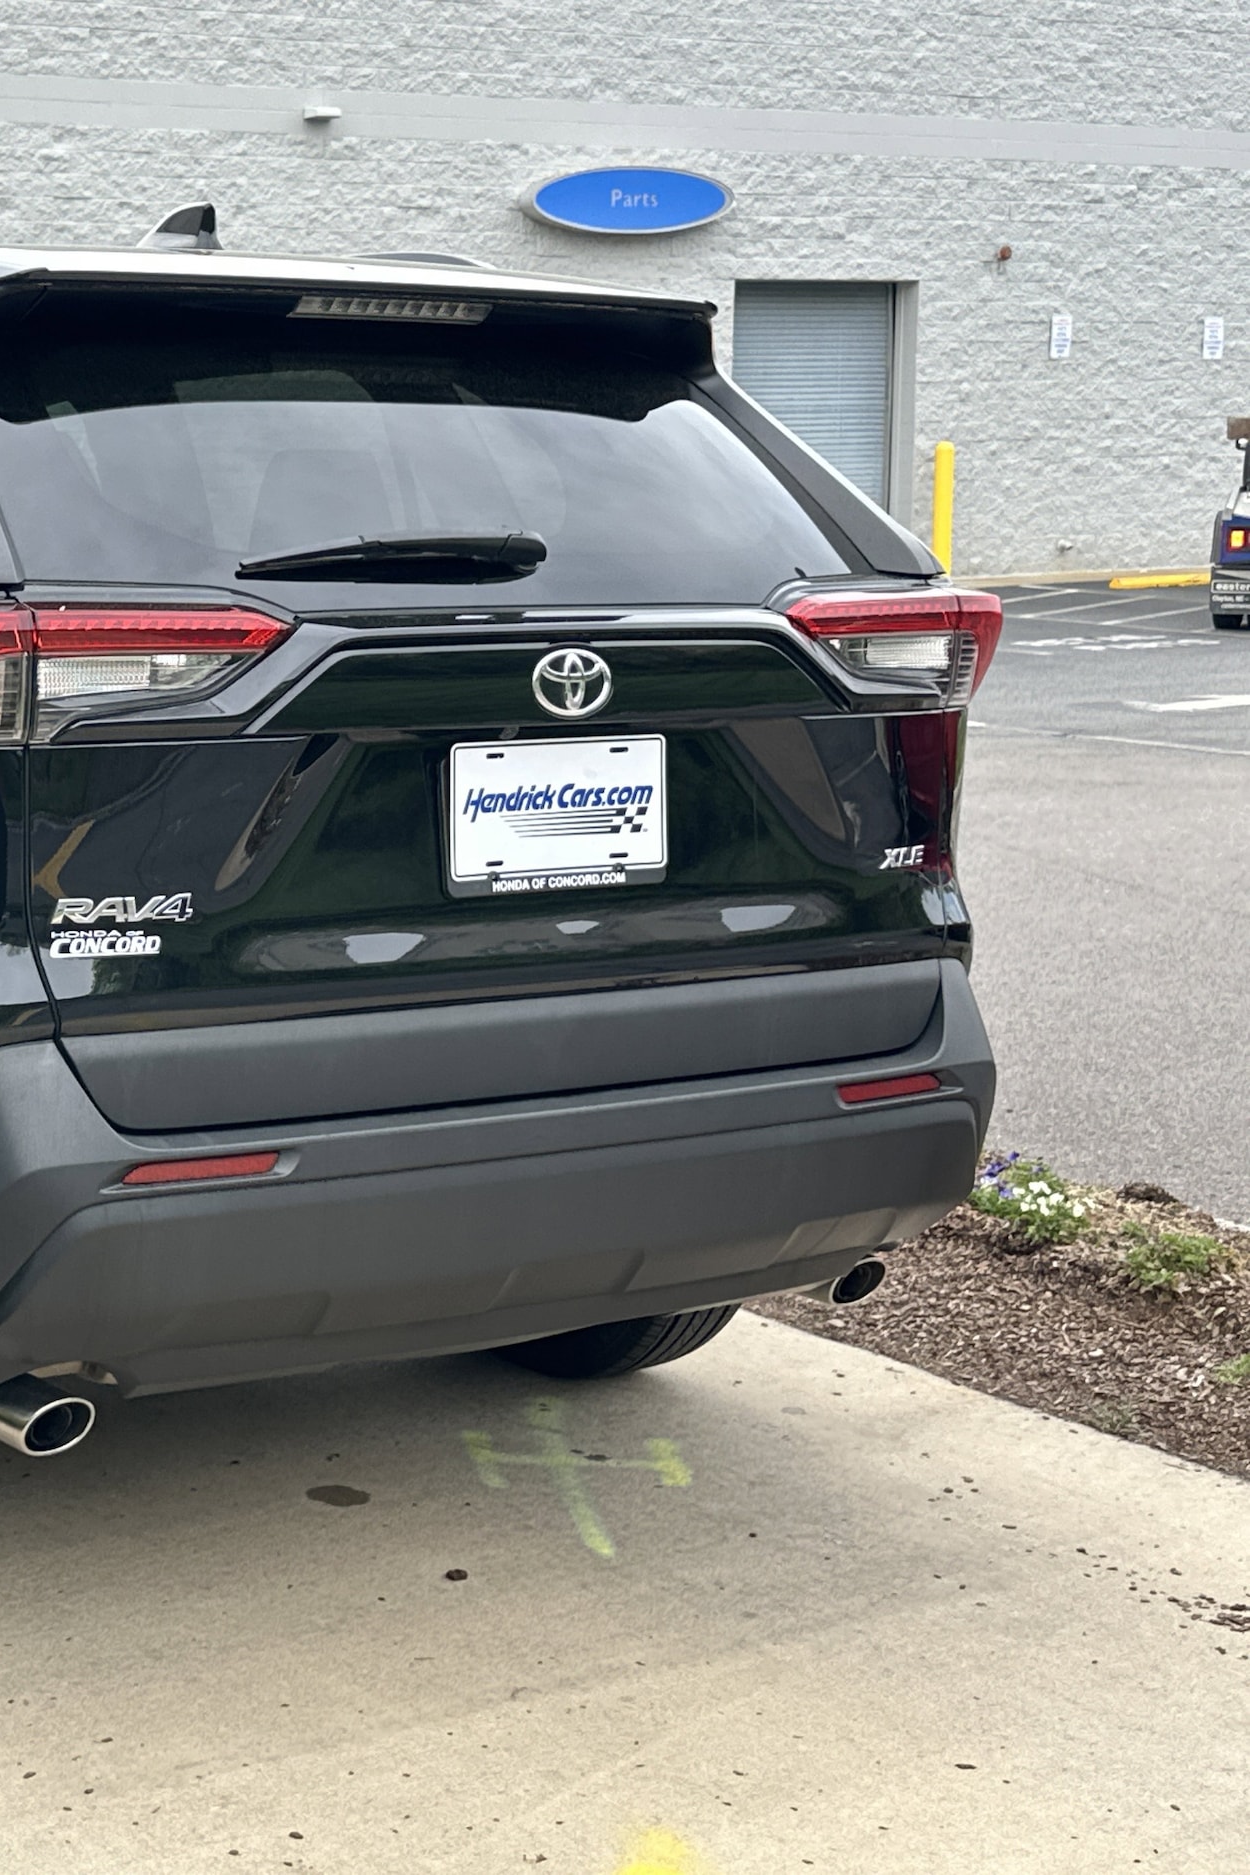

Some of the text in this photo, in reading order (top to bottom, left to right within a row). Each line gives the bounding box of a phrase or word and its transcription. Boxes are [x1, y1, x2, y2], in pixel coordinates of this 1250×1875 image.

[610, 188, 659, 207] Parts
[878, 844, 925, 870] XLE
[492, 871, 627, 893] HONDA OF CONCORD.COM
[50, 892, 194, 925] RAV4
[50, 930, 122, 939] HONDA
[50, 935, 162, 958] CONCORD
